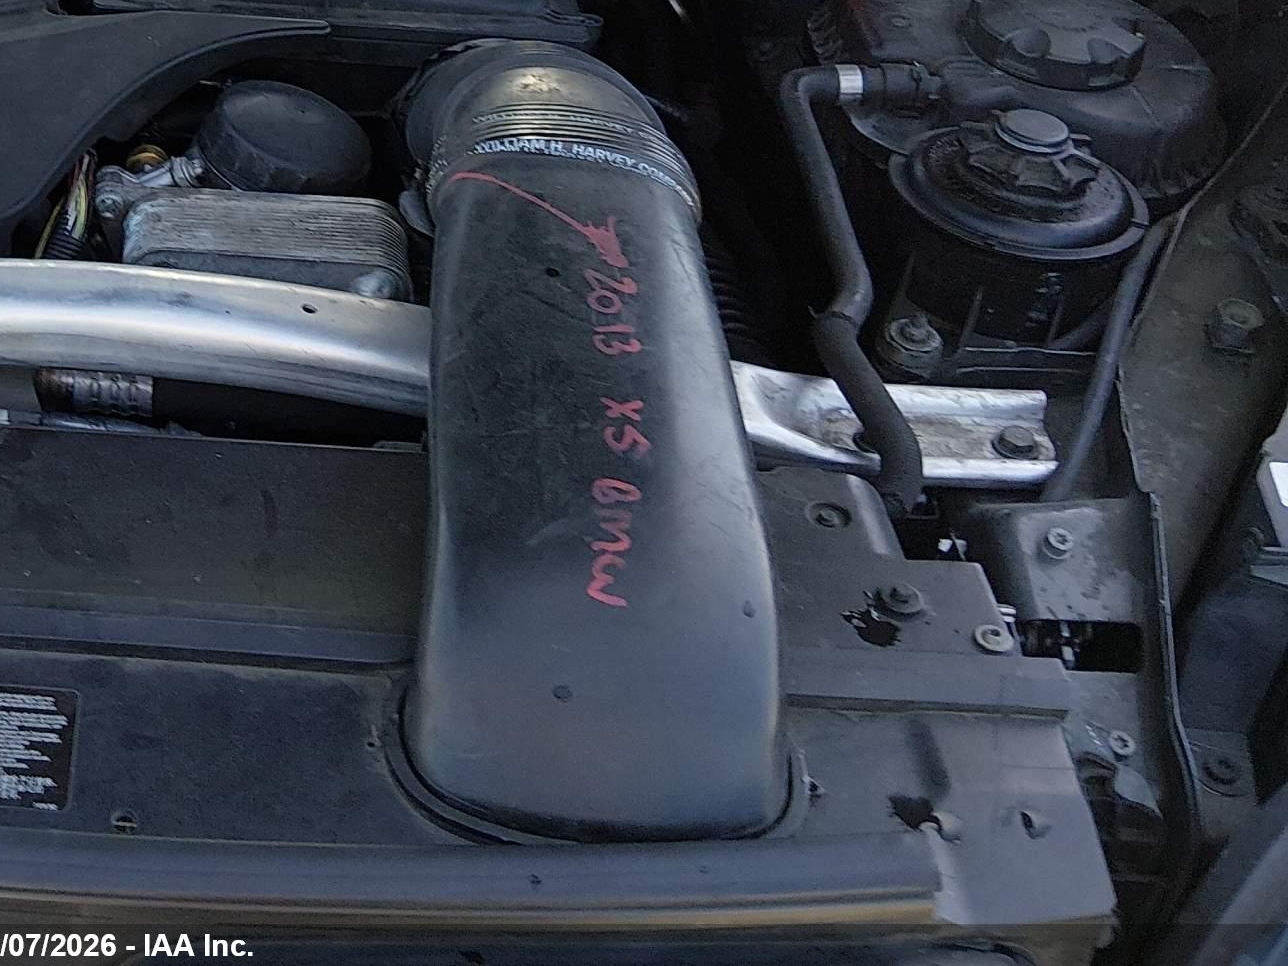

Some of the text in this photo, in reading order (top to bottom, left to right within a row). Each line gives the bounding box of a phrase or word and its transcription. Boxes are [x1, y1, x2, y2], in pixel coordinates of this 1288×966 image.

[571, 143, 637, 168] HARVEY
[584, 268, 652, 608] 2013 X5 BMW
